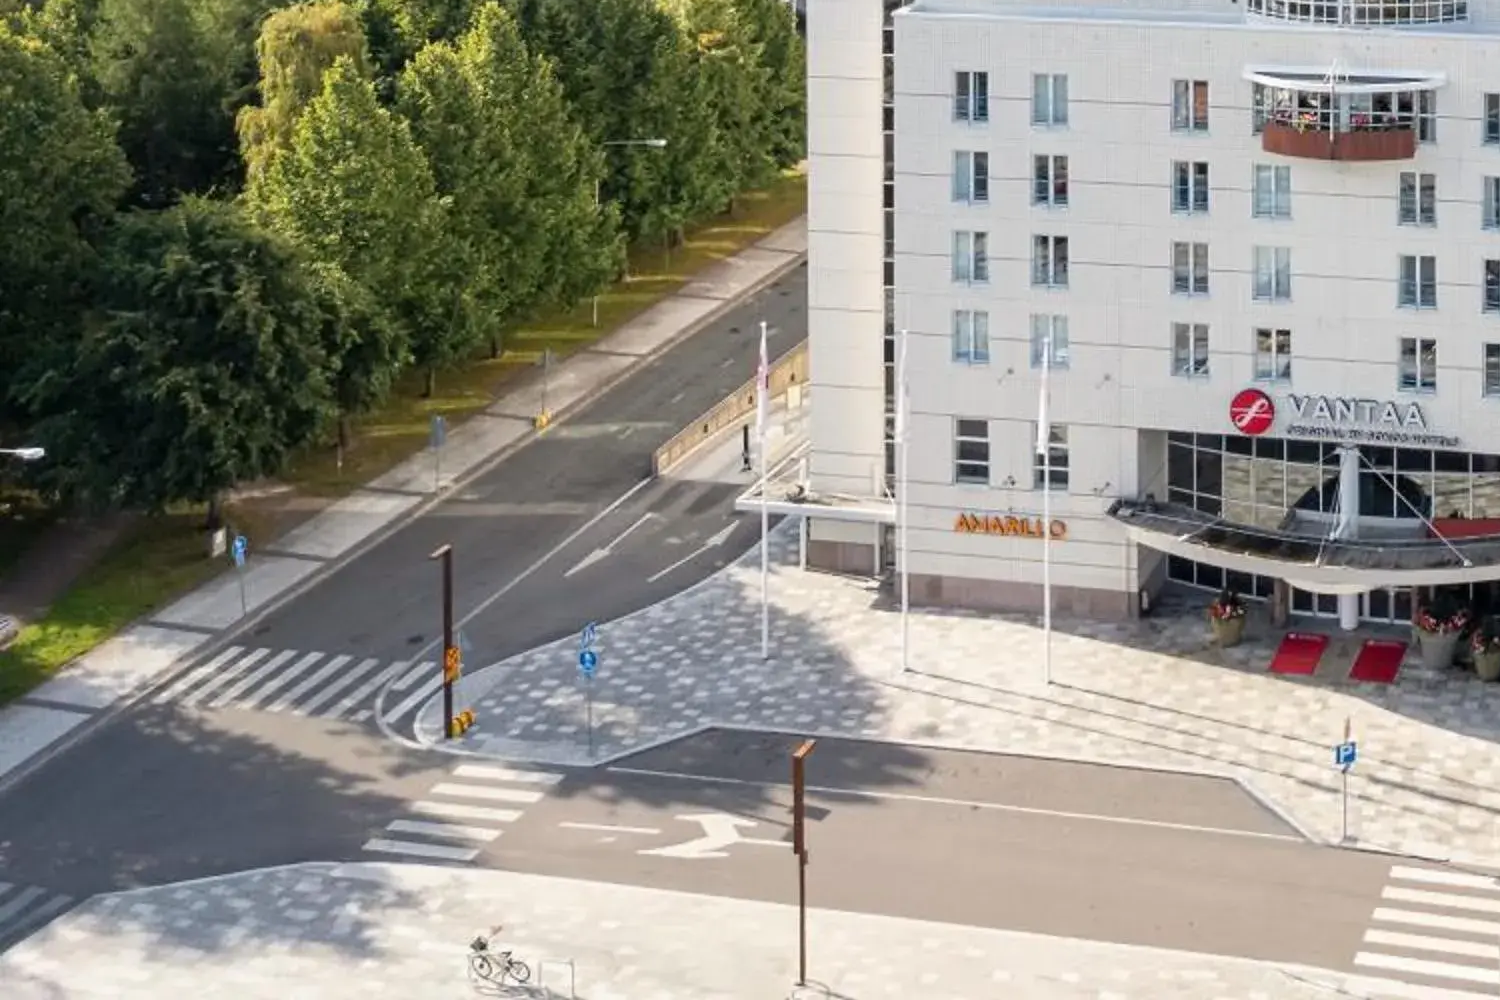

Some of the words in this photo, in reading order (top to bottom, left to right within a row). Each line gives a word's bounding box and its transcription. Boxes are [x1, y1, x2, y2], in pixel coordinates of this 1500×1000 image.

[1288, 393, 1428, 430] VANTAA
[955, 513, 1067, 539] AMARILLO
[1340, 747, 1352, 763] P
